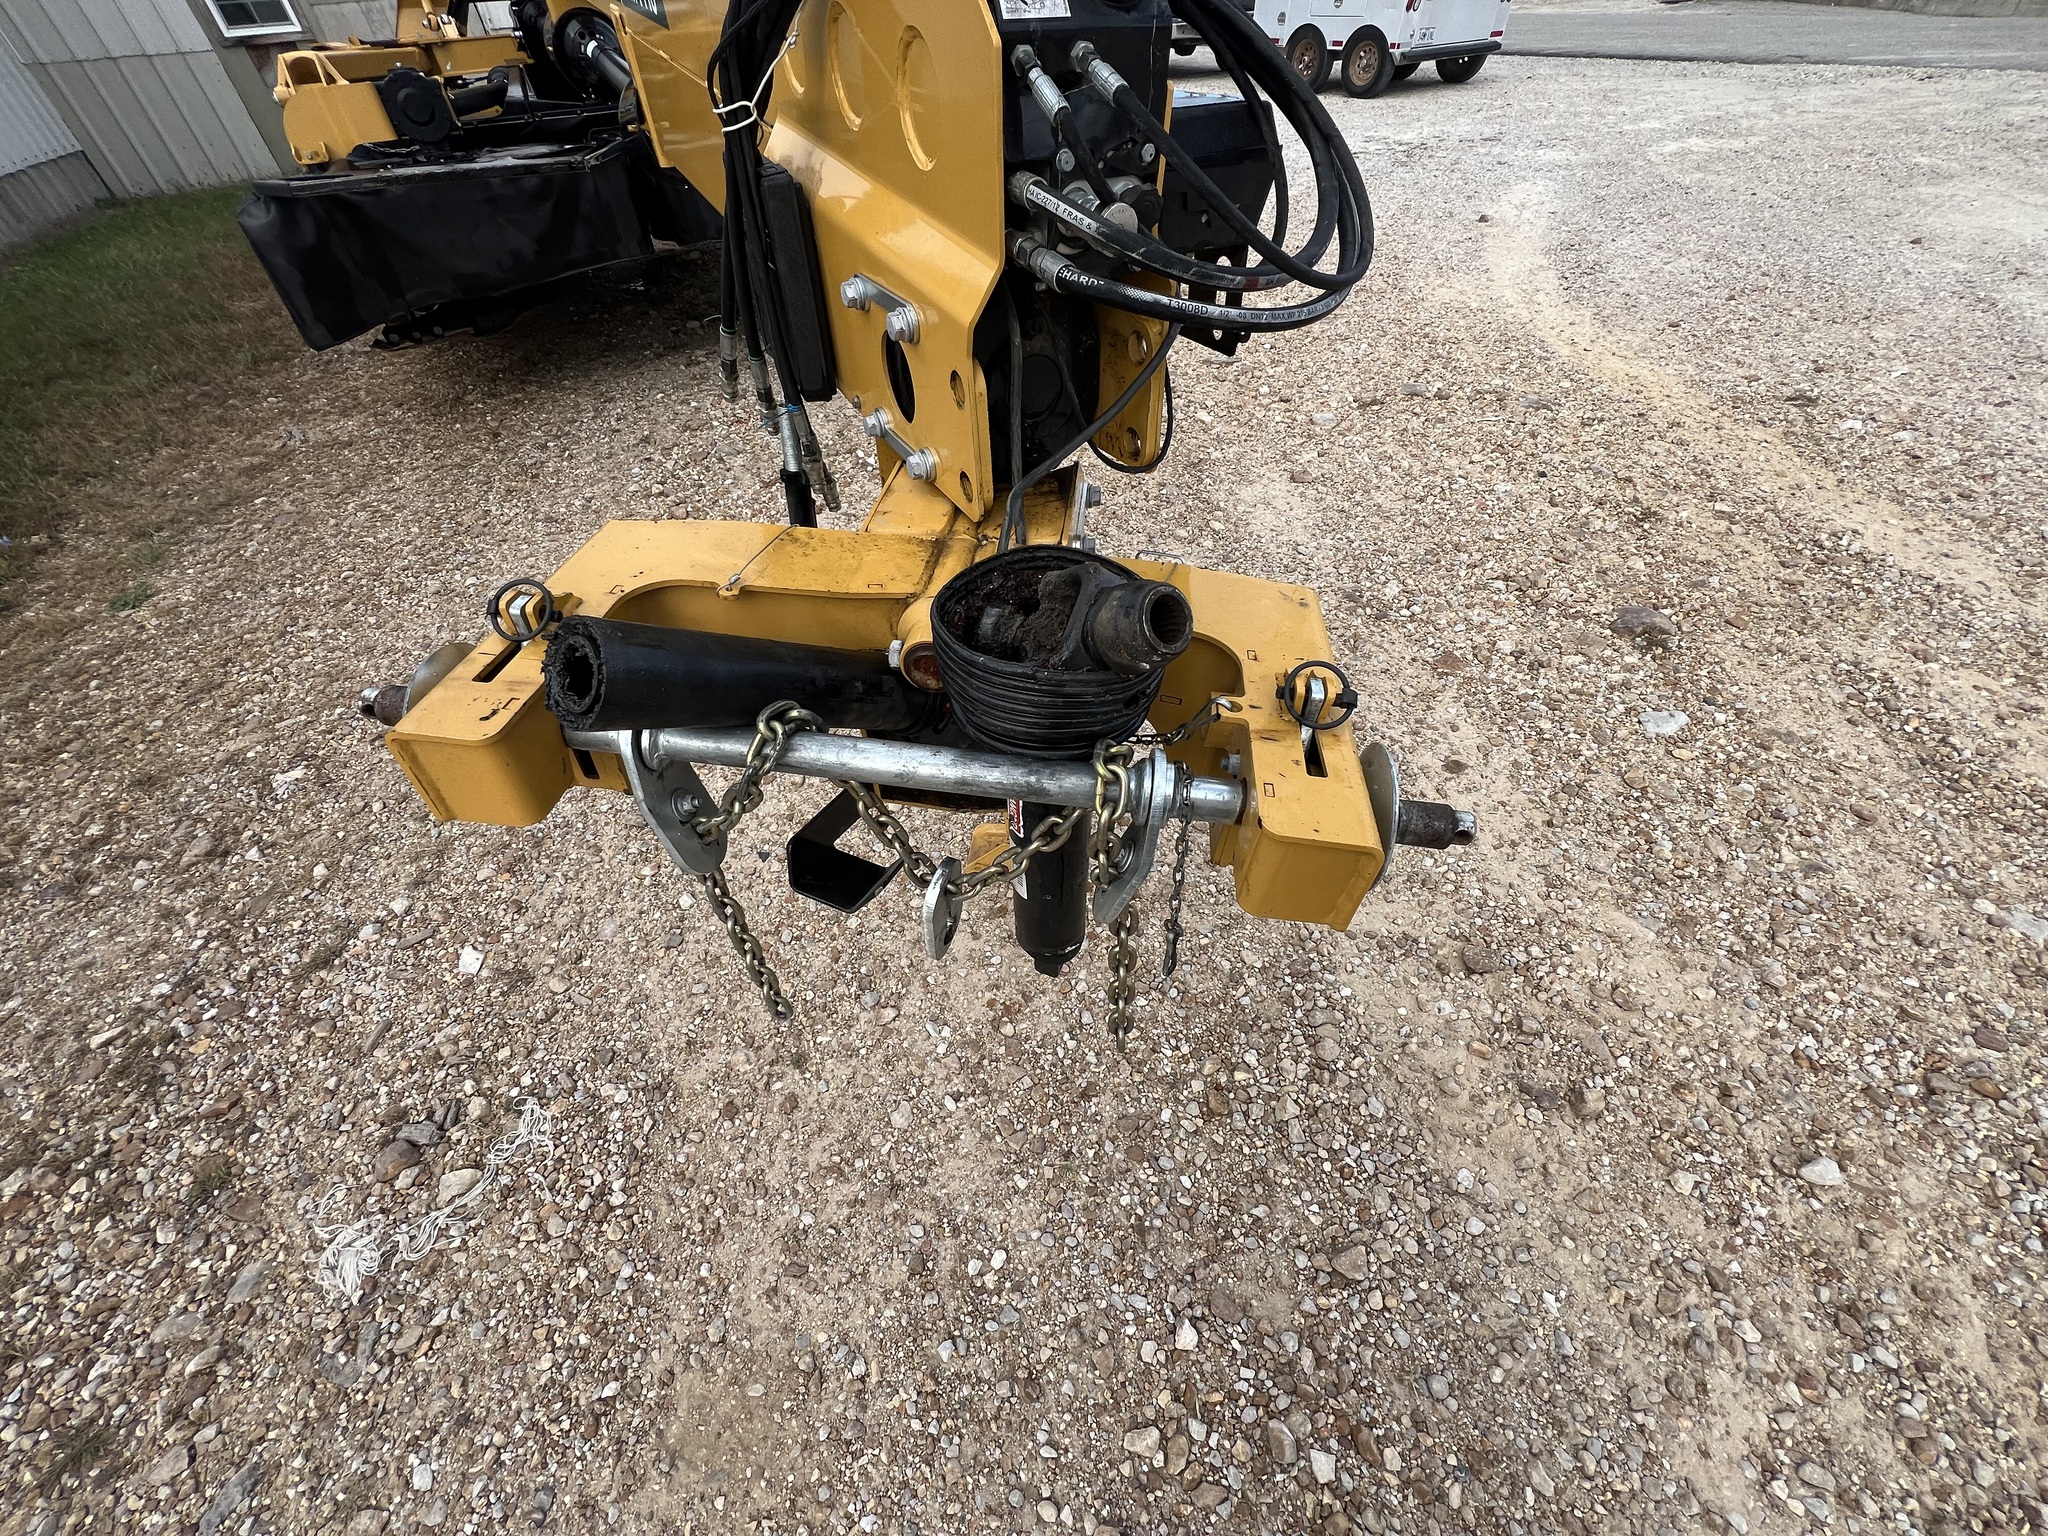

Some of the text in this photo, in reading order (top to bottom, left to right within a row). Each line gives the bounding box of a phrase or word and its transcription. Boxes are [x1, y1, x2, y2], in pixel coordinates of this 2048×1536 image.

[1062, 207, 1085, 226] FRAS
[1085, 222, 1093, 231] &
[1167, 298, 1209, 315] T3008D
